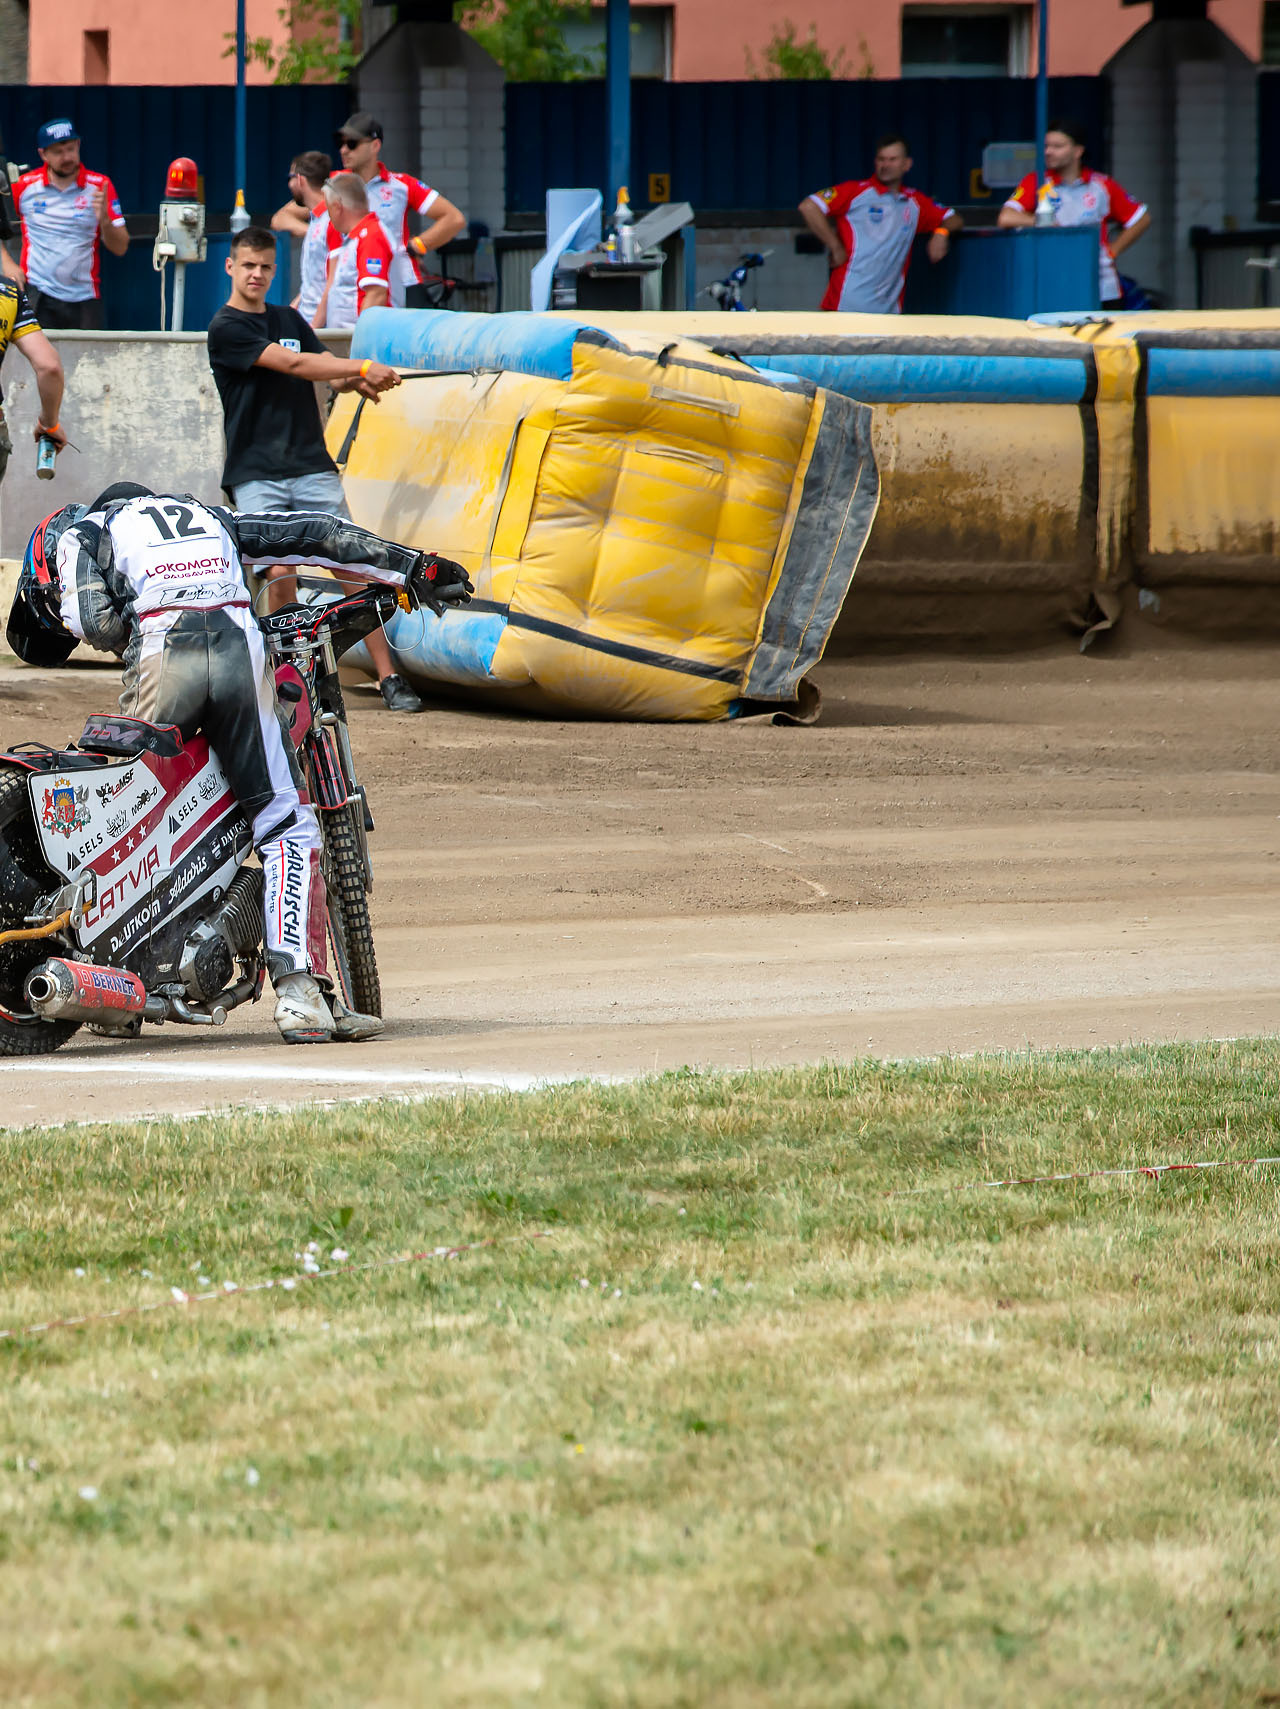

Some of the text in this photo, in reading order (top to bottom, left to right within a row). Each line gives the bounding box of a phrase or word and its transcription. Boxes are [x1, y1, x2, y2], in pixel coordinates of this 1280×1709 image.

[138, 505, 207, 540] 12
[145, 557, 230, 578] LOKOMOTIV
[163, 568, 225, 580] DAUGAVPILS
[178, 796, 198, 821] SELS
[80, 833, 103, 858] SELS
[85, 844, 160, 928] LATVIA
[90, 970, 136, 996] BERNER
